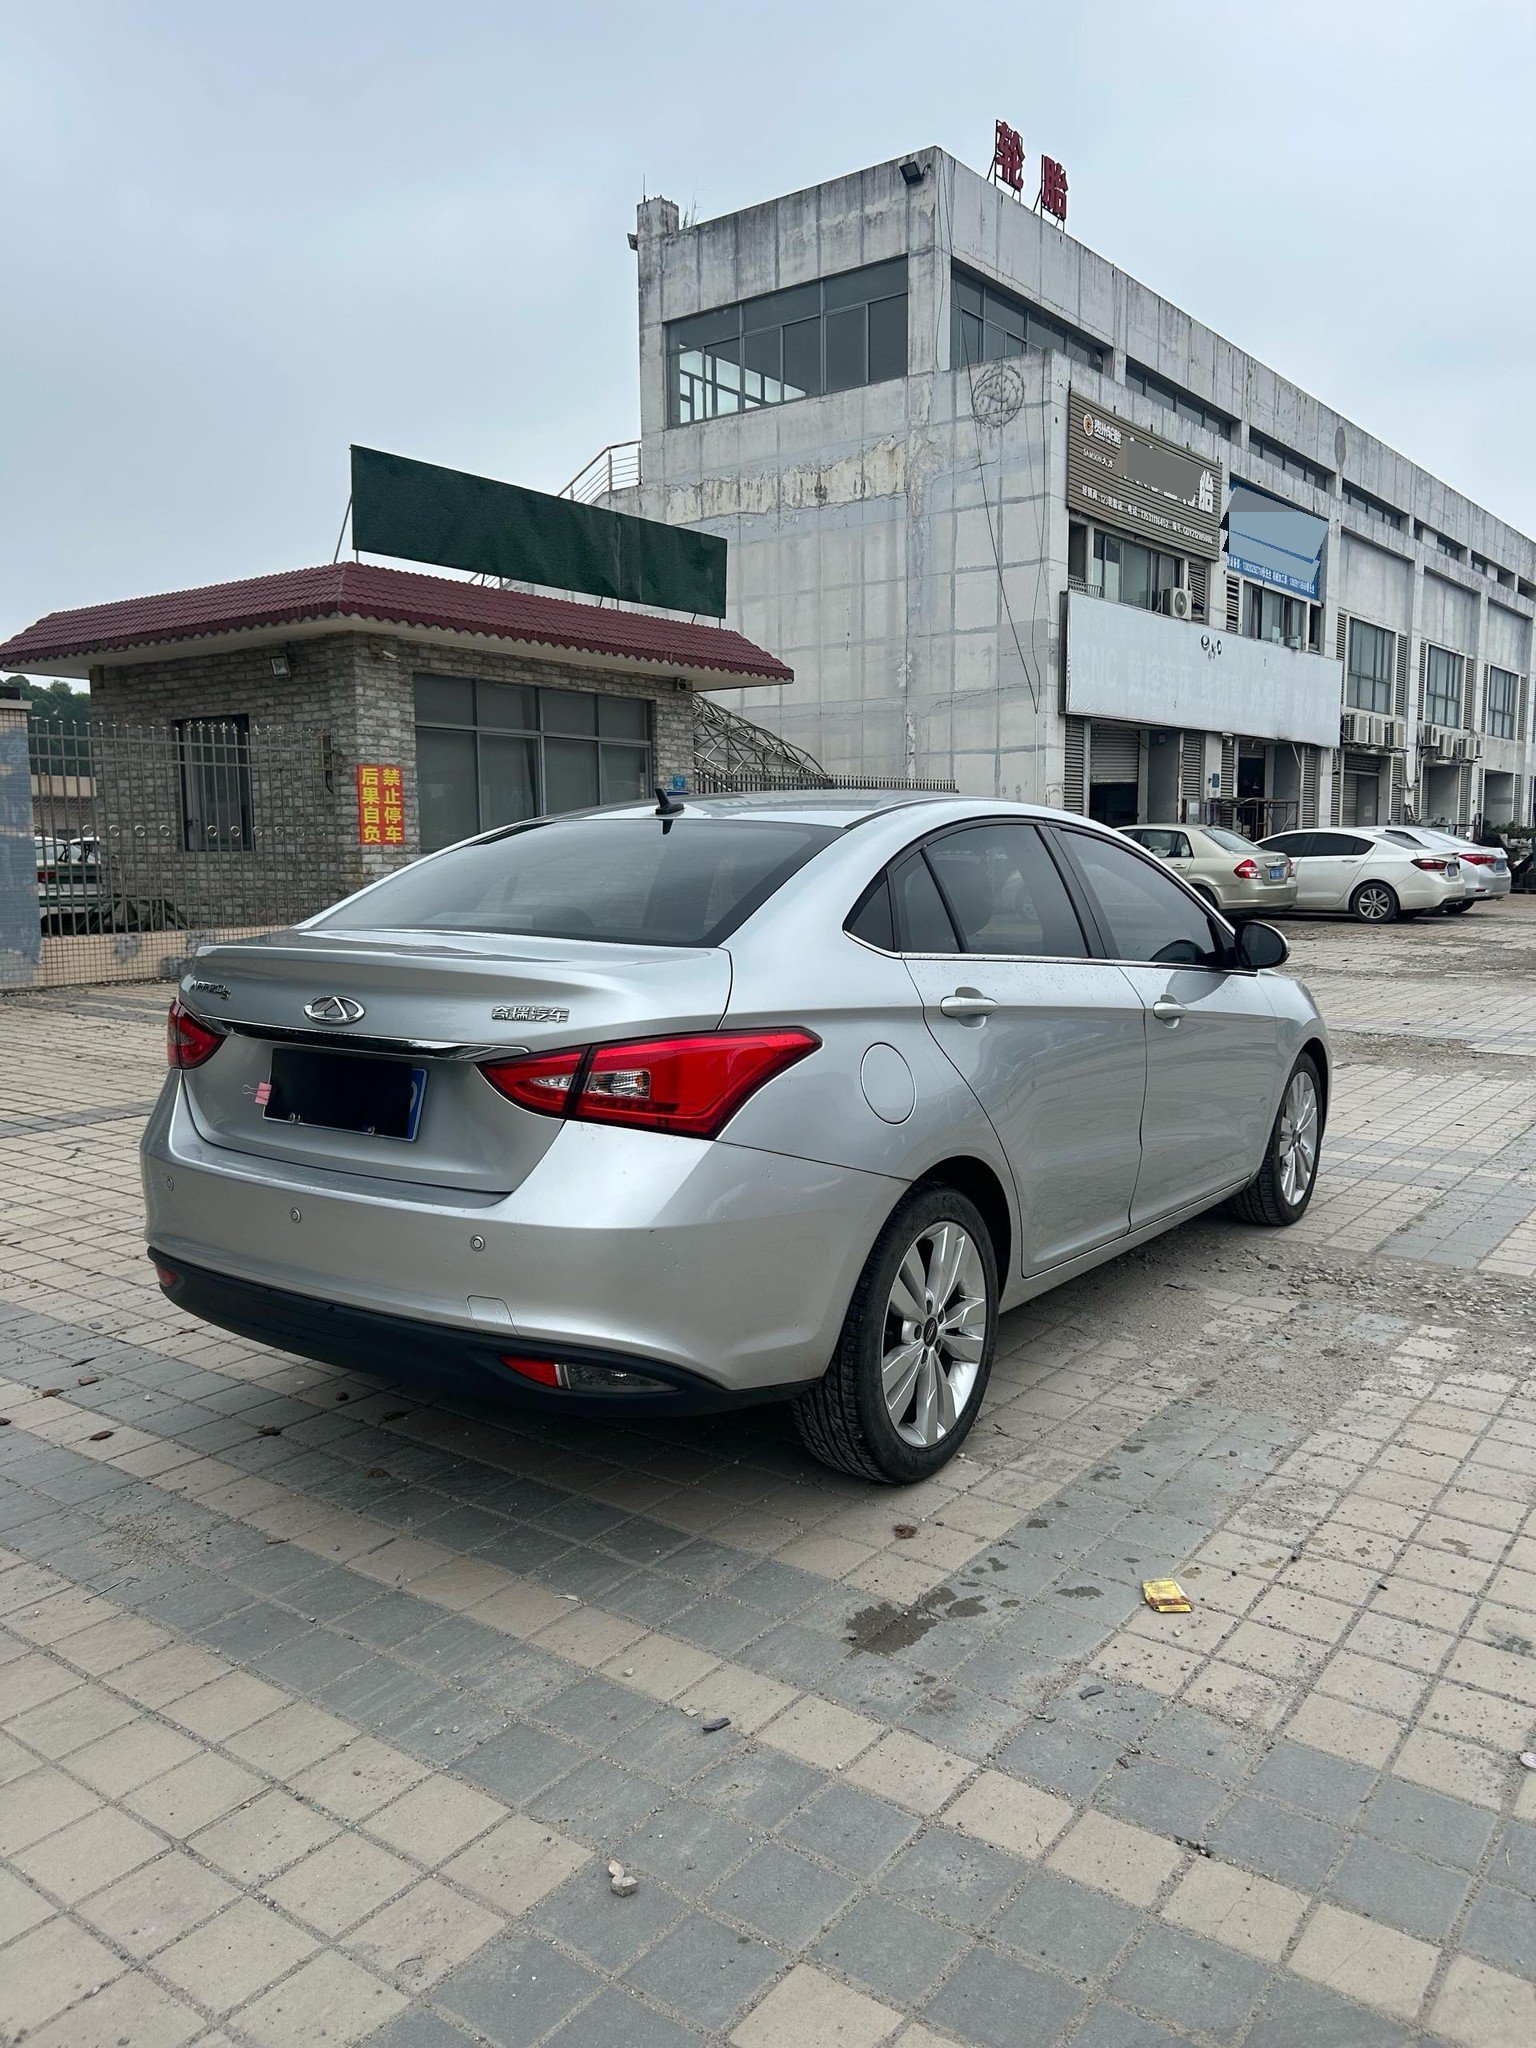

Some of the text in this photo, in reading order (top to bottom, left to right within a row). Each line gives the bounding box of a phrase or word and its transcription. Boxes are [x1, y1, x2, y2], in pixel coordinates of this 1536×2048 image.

[361, 768, 381, 843] 后果自负
[383, 768, 403, 843] 禁止停车
[492, 1004, 570, 1024] 奇瑞汽车
